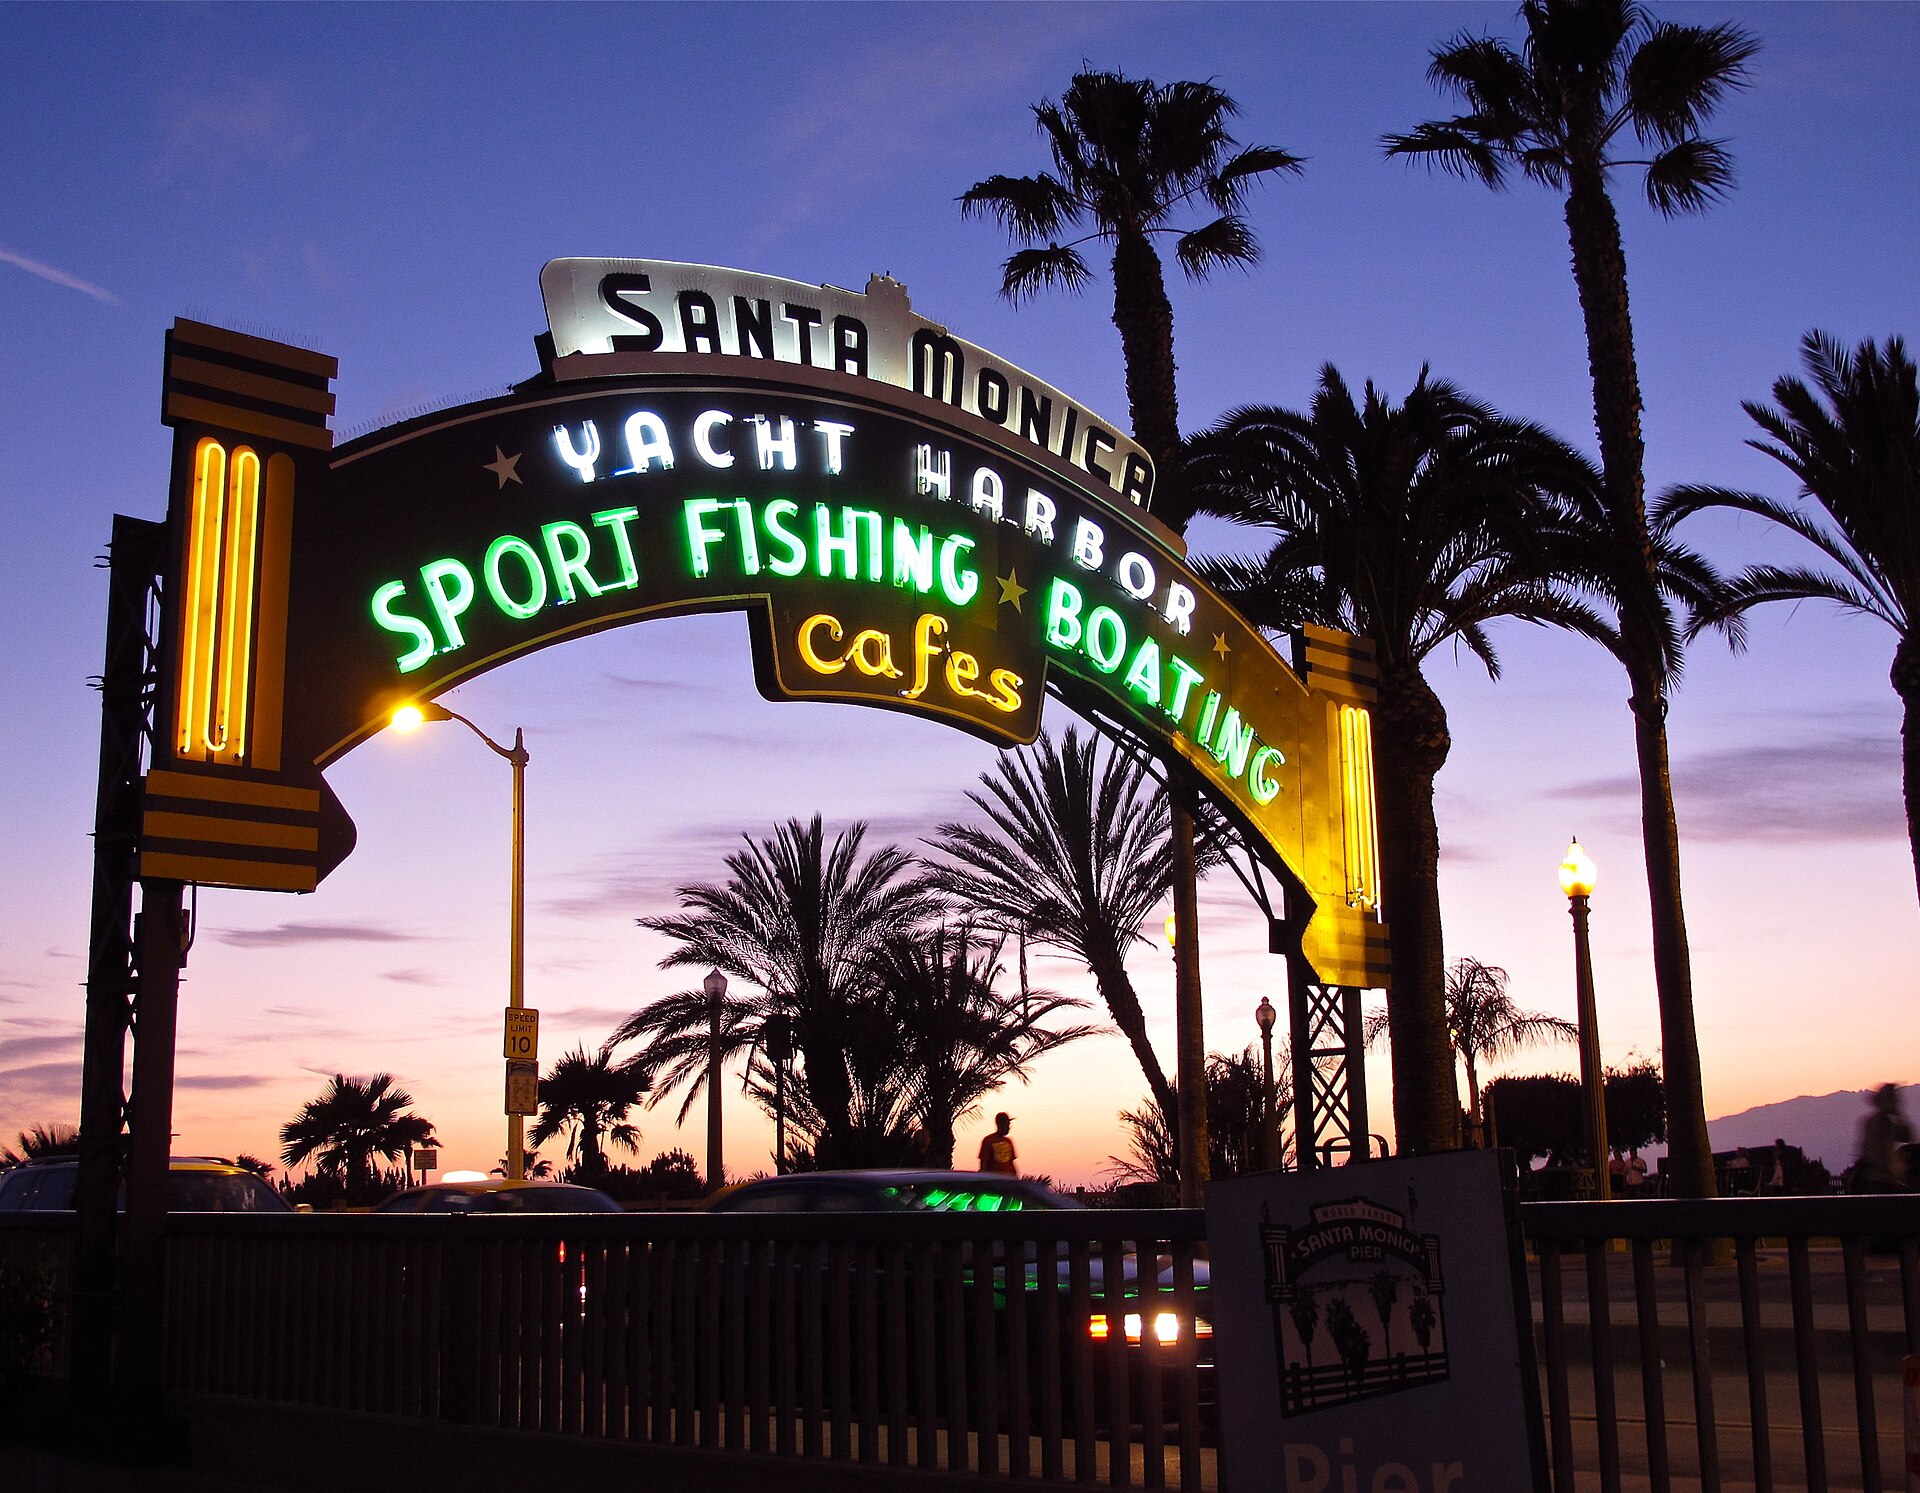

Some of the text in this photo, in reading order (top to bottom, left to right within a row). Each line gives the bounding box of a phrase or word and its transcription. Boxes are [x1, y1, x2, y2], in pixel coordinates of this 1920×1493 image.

[602, 273, 1154, 509] SANTA MONICA
[552, 409, 1196, 636] YACHT HARBOR
[370, 497, 1286, 806] SPORT FISHING BOATING
[509, 1014, 535, 1023] SPEED
[511, 1025, 532, 1033] LIMIT
[511, 1036, 531, 1053] 10
[1322, 1207, 1355, 1218] WORLD
[1297, 1224, 1420, 1259] SANTA MONICA
[1351, 1245, 1382, 1259] PIER
[1282, 1438, 1464, 1493] Pier
